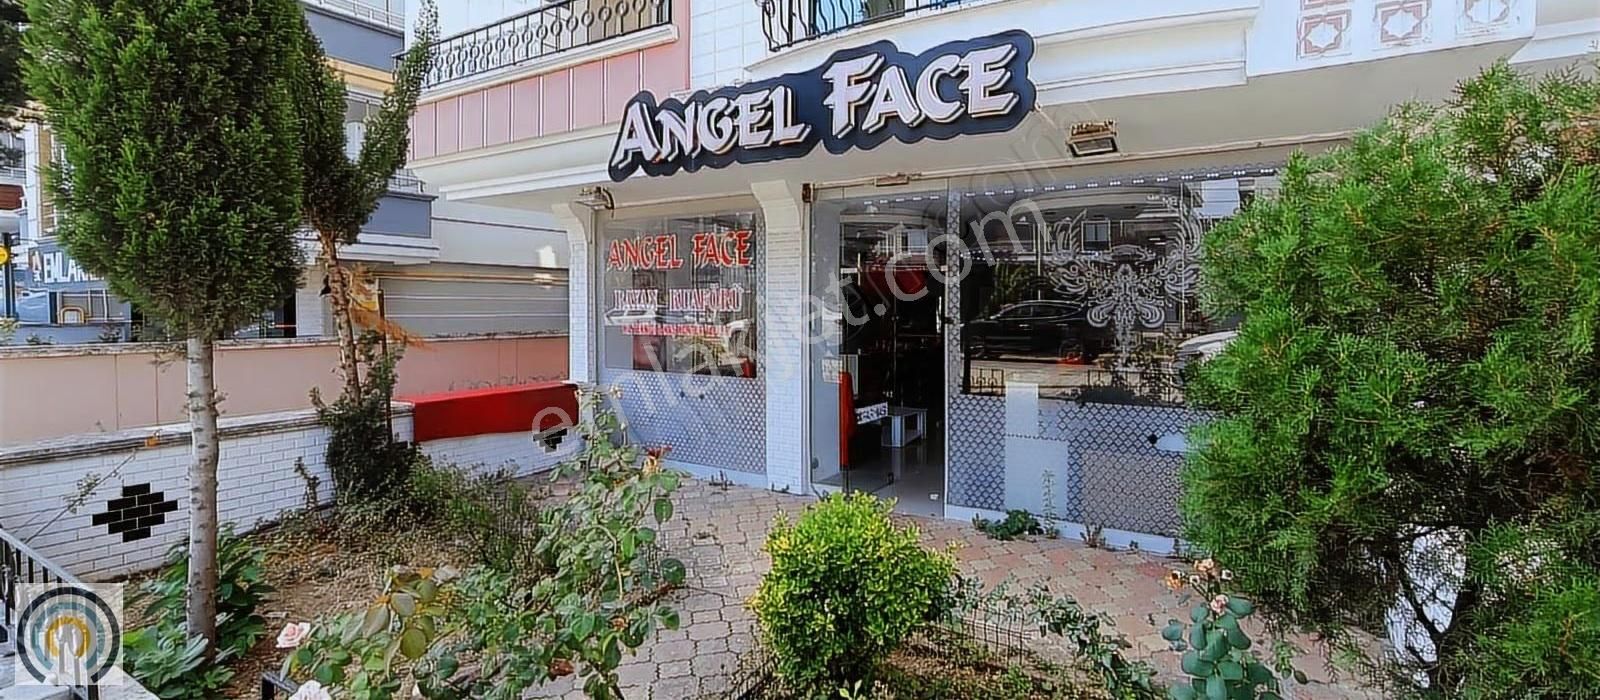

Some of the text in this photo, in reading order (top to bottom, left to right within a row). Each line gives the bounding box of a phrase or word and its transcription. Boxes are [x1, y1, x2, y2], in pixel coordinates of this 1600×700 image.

[612, 43, 1018, 169] ANGEL FACE
[606, 229, 753, 271] ANGEL FACE
